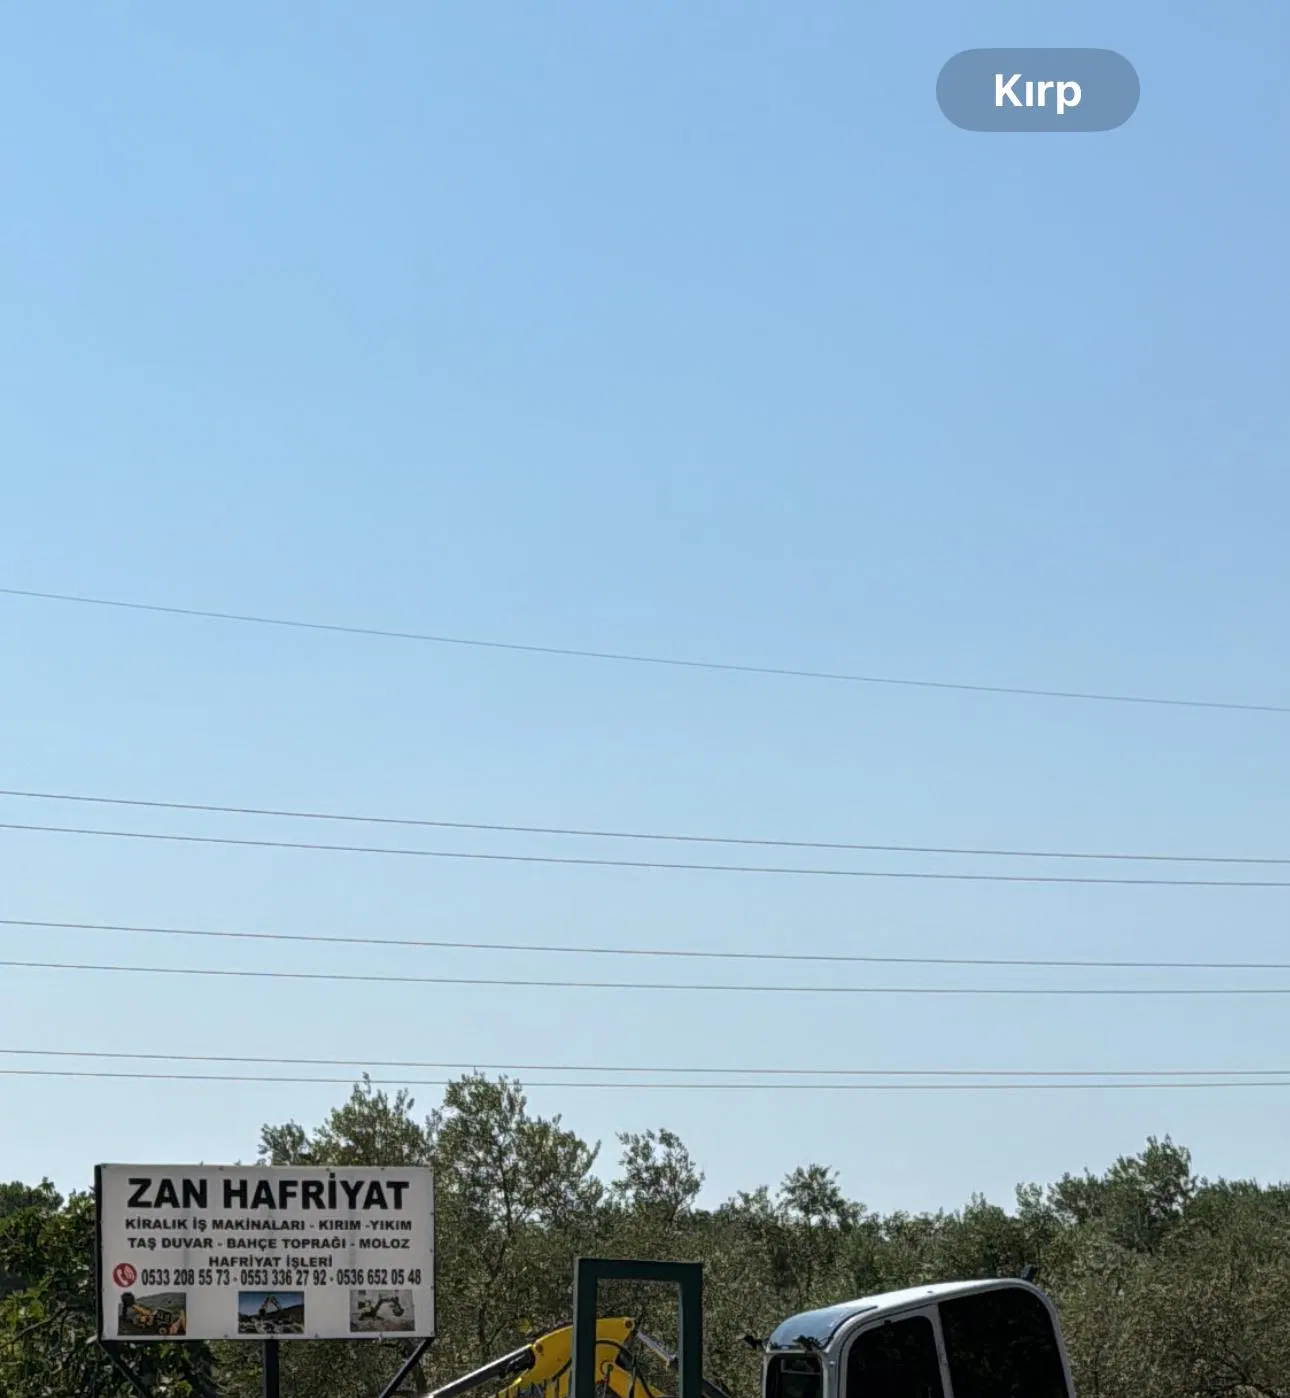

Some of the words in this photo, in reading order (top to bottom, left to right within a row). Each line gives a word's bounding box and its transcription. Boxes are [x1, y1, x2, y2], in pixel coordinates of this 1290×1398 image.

[127, 1177, 208, 1208] ZAN
[223, 1172, 410, 1210] HAFRİYAT
[125, 1216, 188, 1230] KİRALIK
[193, 1216, 208, 1232] İŞ
[212, 1217, 305, 1231] MAKİNALARI
[319, 1219, 361, 1231] KIRIM
[127, 1237, 157, 1251] TAŞ
[161, 1238, 213, 1249] DUVAR
[227, 1238, 277, 1251] BAHÇE
[282, 1236, 346, 1249] TOPRAĞI
[359, 1238, 411, 1249] MOLOZ
[208, 1254, 281, 1267] HAFRİYAT
[286, 1254, 333, 1270] İŞLERİ
[141, 1268, 170, 1286] 0533
[173, 1268, 195, 1286] 208
[198, 1268, 213, 1286] 55
[216, 1268, 230, 1286] 73
[240, 1268, 268, 1286] 0553
[272, 1268, 292, 1286] 336
[296, 1268, 310, 1286] 27
[313, 1268, 327, 1286] 92
[337, 1268, 364, 1286] 0536
[367, 1268, 388, 1286] 652
[391, 1268, 405, 1286] 05
[407, 1268, 422, 1286] 48
